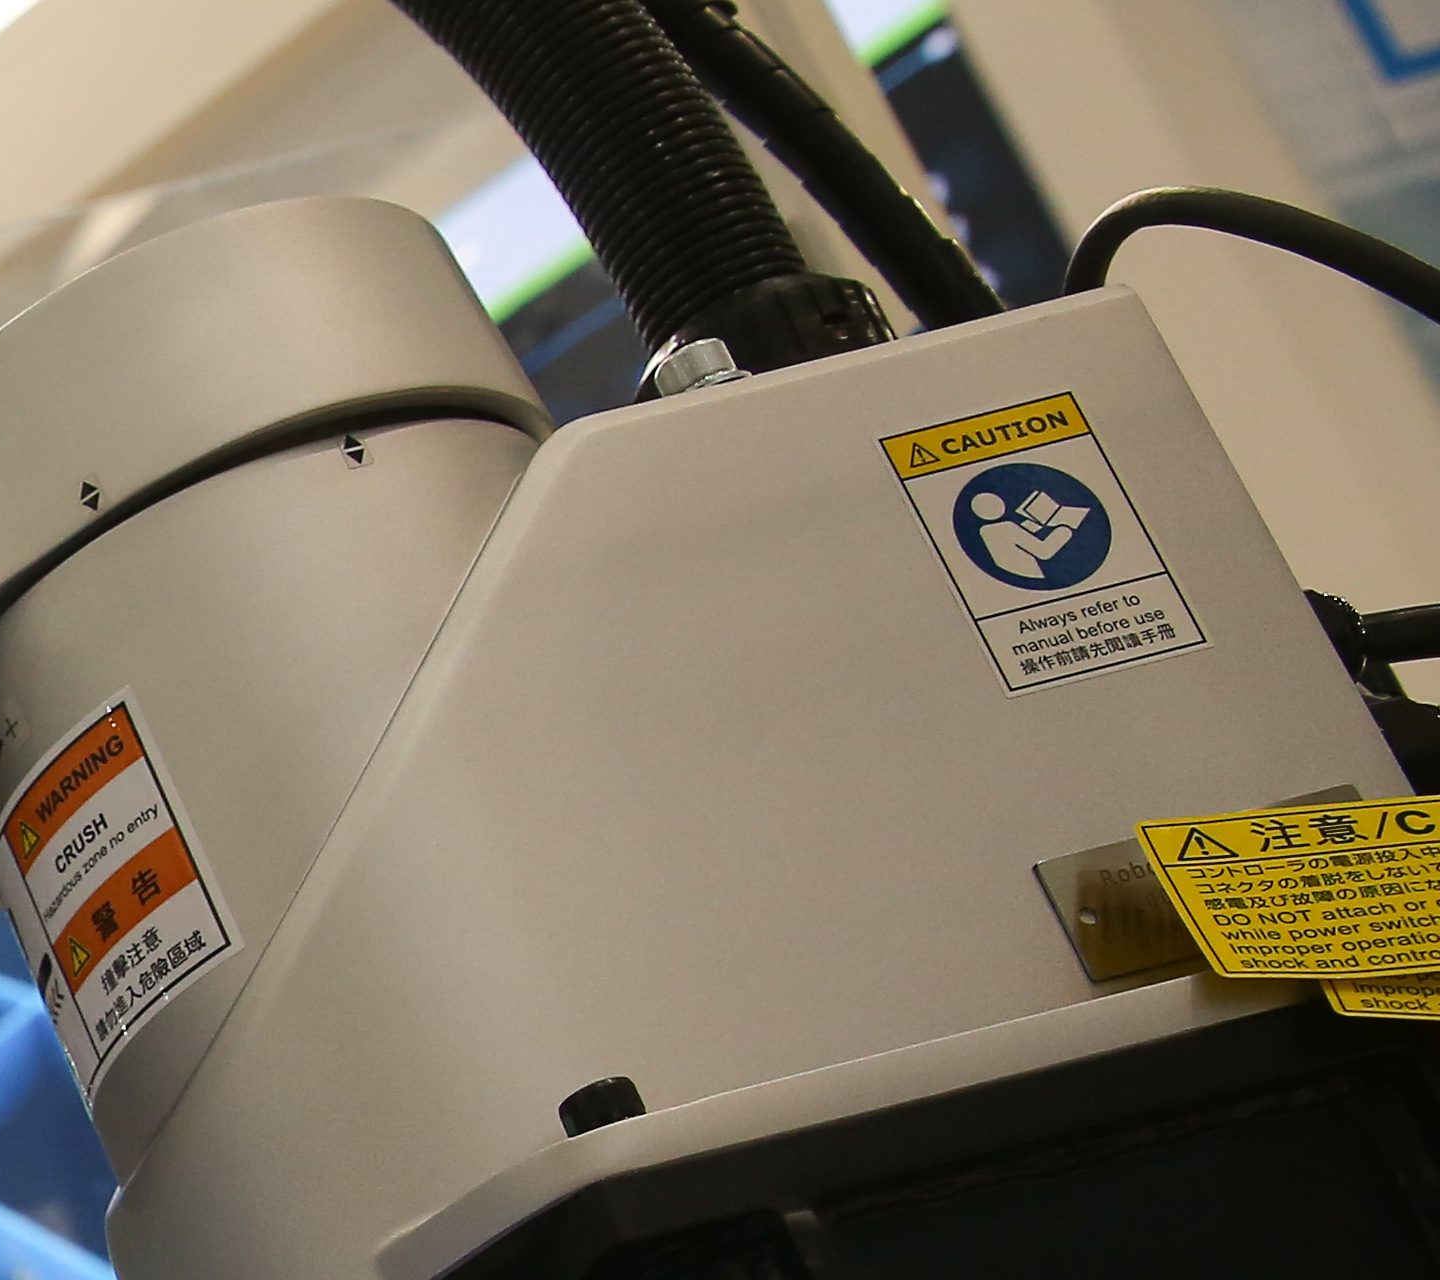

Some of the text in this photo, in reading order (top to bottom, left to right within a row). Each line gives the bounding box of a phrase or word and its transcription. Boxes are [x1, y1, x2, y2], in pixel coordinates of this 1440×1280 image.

[940, 410, 1070, 456] CAUTION
[1012, 608, 1166, 656] manual before use
[1018, 592, 1141, 634] Always refer to
[35, 733, 126, 824] WARNING
[44, 804, 159, 922] Hazardous zone no entry
[54, 812, 109, 874] CRUSH
[91, 868, 162, 943] 警告
[1213, 900, 1427, 926] DO NOT attach or
[1221, 928, 1281, 941] while
[1288, 922, 1361, 942] power
[1229, 940, 1333, 957] Improper
[100, 926, 164, 996] 撞擊注意
[1240, 957, 1308, 970] shock
[1316, 954, 1360, 970] and
[94, 929, 207, 1042] 請勿進入危險區域
[1360, 996, 1432, 1011] shock
